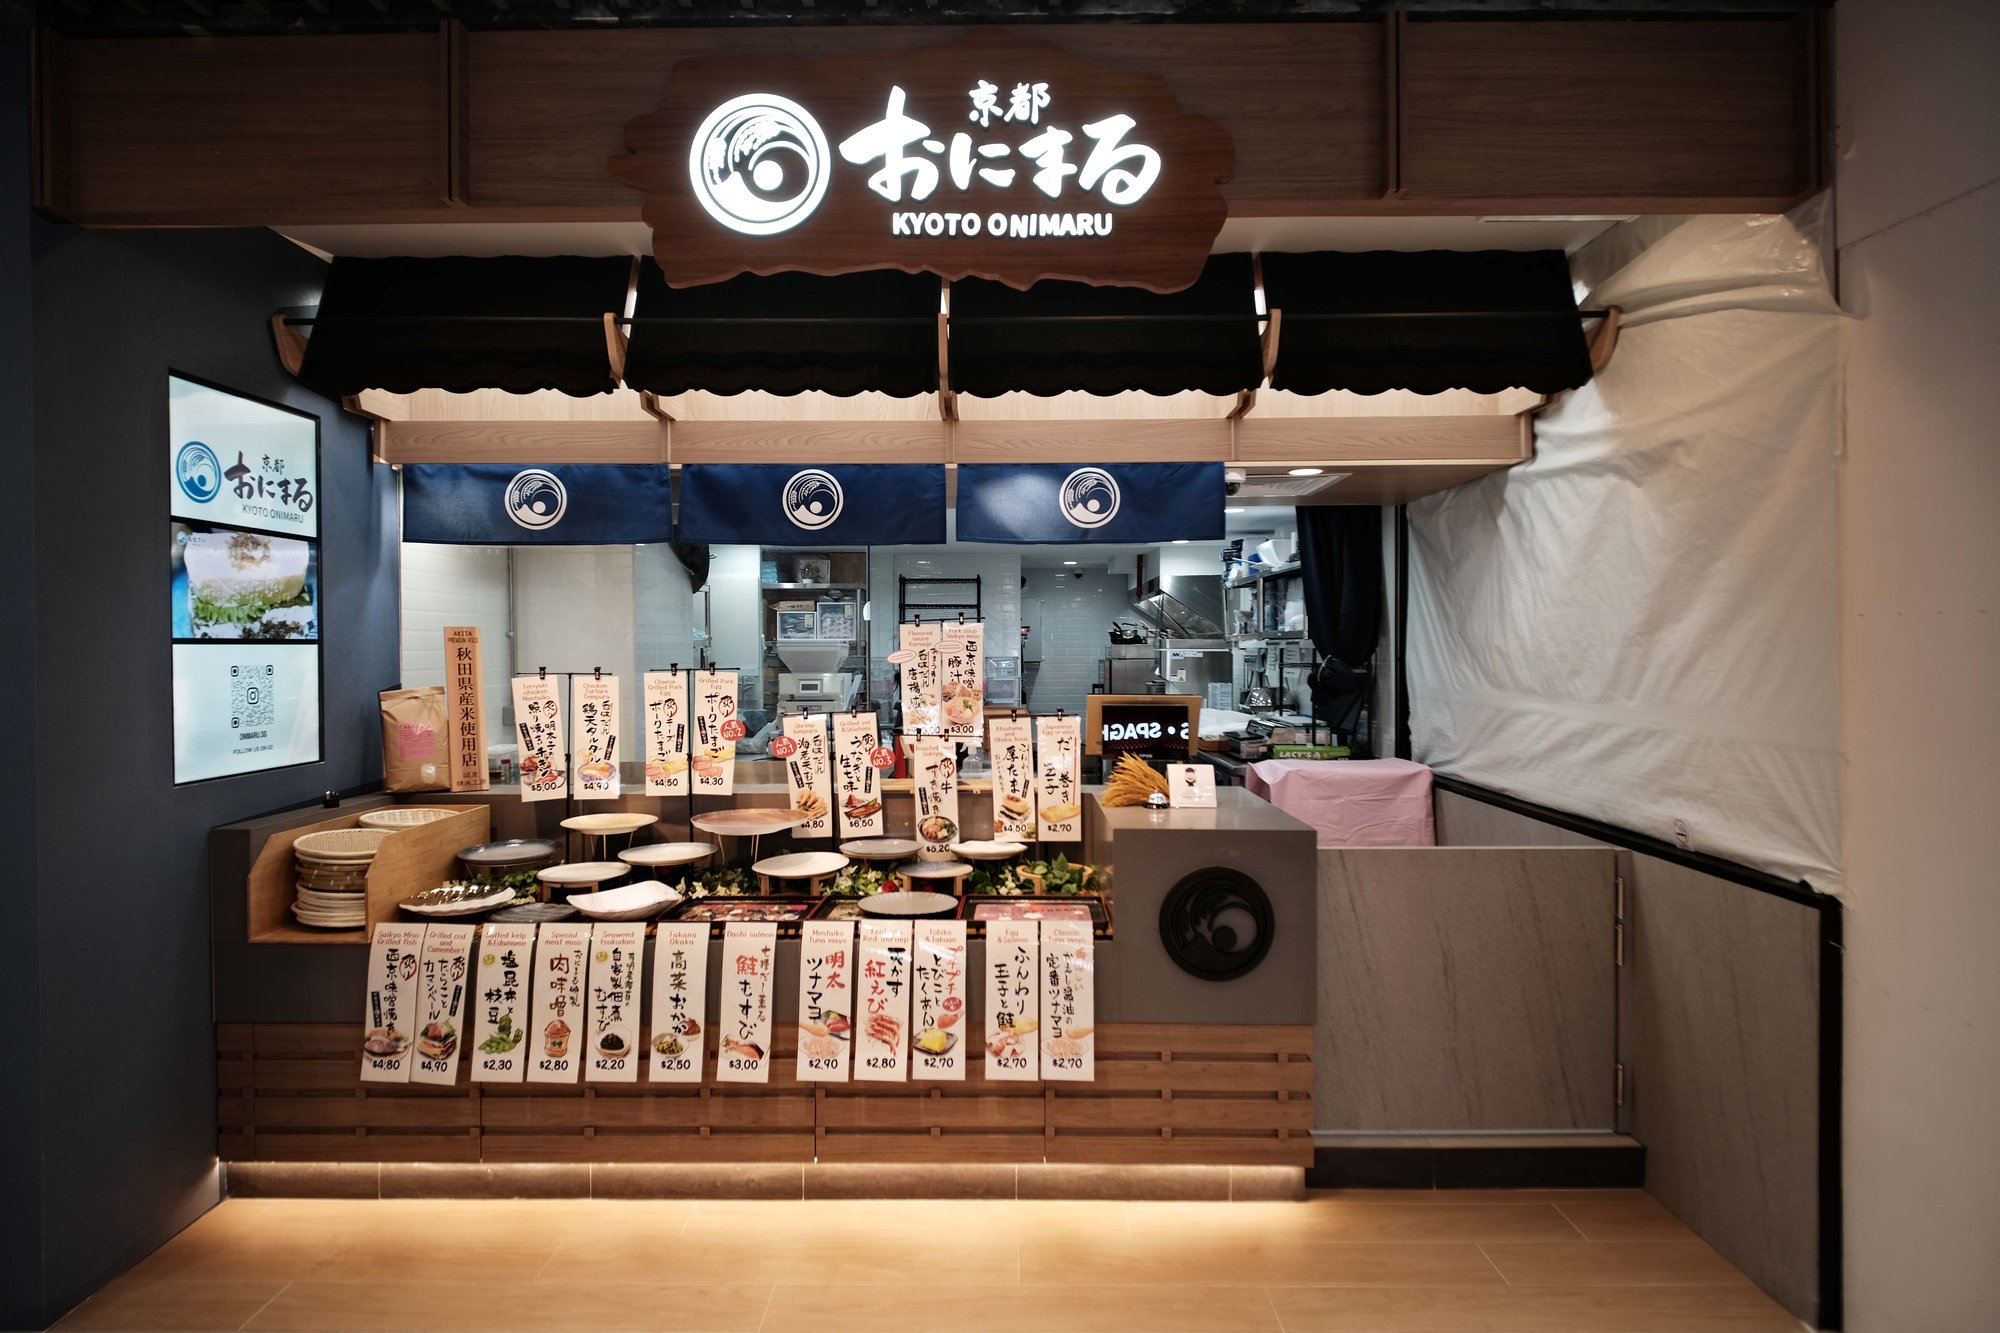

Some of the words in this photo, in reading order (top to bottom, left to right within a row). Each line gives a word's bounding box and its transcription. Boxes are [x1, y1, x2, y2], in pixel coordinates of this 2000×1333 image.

[968, 79, 1051, 128] 京都
[838, 85, 1162, 205] おにまる
[892, 212, 981, 236] KYOTO
[987, 213, 1113, 238] ONIMARU
[262, 454, 285, 475] 京都
[224, 450, 313, 513] おにまる
[242, 504, 268, 517] KYOTO
[269, 509, 304, 523] ONIMARU
[948, 656, 962, 682] 豚汁
[963, 641, 977, 689] 西京味噌
[456, 647, 477, 767] 秋田県産米使用店
[649, 699, 671, 762] ポークたまご
[705, 692, 725, 759] ポークたまご
[723, 728, 742, 738] NO.2
[951, 725, 974, 734] $3.00
[528, 701, 548, 777] 照り焼きチキン
[776, 745, 795, 755] NO.1
[798, 737, 815, 791] 海老天むす
[873, 756, 893, 766] NO.3
[840, 754, 859, 793] 生七味
[1003, 745, 1020, 793] 厚たま
[531, 782, 557, 791] $5.00
[584, 782, 609, 791] $4.90
[655, 778, 679, 787] $4.50
[700, 777, 723, 786] $4.30
[801, 820, 824, 829] $4.80
[849, 819, 874, 828] $6.50
[1004, 824, 1027, 833] $4.50
[1048, 824, 1072, 832] $2.70
[378, 931, 401, 939] Saikyo
[454, 932, 466, 940] cod
[511, 932, 527, 940] kelp
[551, 931, 578, 939] Special
[726, 930, 747, 938] Dashi
[749, 930, 775, 938] salmon
[812, 929, 844, 937] Mentaiko
[1005, 928, 1019, 936] Egg
[1054, 928, 1080, 936] Classic
[427, 946, 465, 954] Camembert
[825, 950, 845, 989] 明太
[438, 958, 449, 1009] たらこと
[500, 950, 519, 1014] 塩昆布と
[549, 953, 570, 1018] 肉味噌
[608, 947, 623, 1022] 自家製佃煮
[864, 959, 888, 1014] 紅えび
[932, 953, 947, 1007] とびこと
[1014, 946, 1030, 1016] ふんわり
[383, 948, 400, 1037] 西京味噌焼き
[423, 960, 441, 1020] カマンベール
[669, 950, 688, 1035] 高菜おかか
[807, 957, 823, 1020] ツナマヨ
[916, 965, 935, 1027] たくあん
[994, 963, 1016, 1028] 玉子と鮭
[1046, 952, 1062, 1039] 定番ツナマヨ
[736, 954, 758, 1040] 鮭むすび
[484, 988, 502, 1025] 枝豆
[594, 986, 611, 1032] むすび
[372, 1059, 400, 1071] $4.80
[420, 1061, 448, 1072] $4.90
[483, 1059, 512, 1071] $2.30
[539, 1059, 568, 1071] $2.80
[595, 1059, 625, 1071] $2.20
[661, 1059, 690, 1071] $2.50
[728, 1059, 758, 1071] $3.00
[808, 1059, 838, 1070] $2.90
[866, 1057, 896, 1069] $2.80
[923, 1058, 954, 1069] $2.70
[997, 1057, 1027, 1069] $2.70
[1053, 1058, 1083, 1070] $2.70
